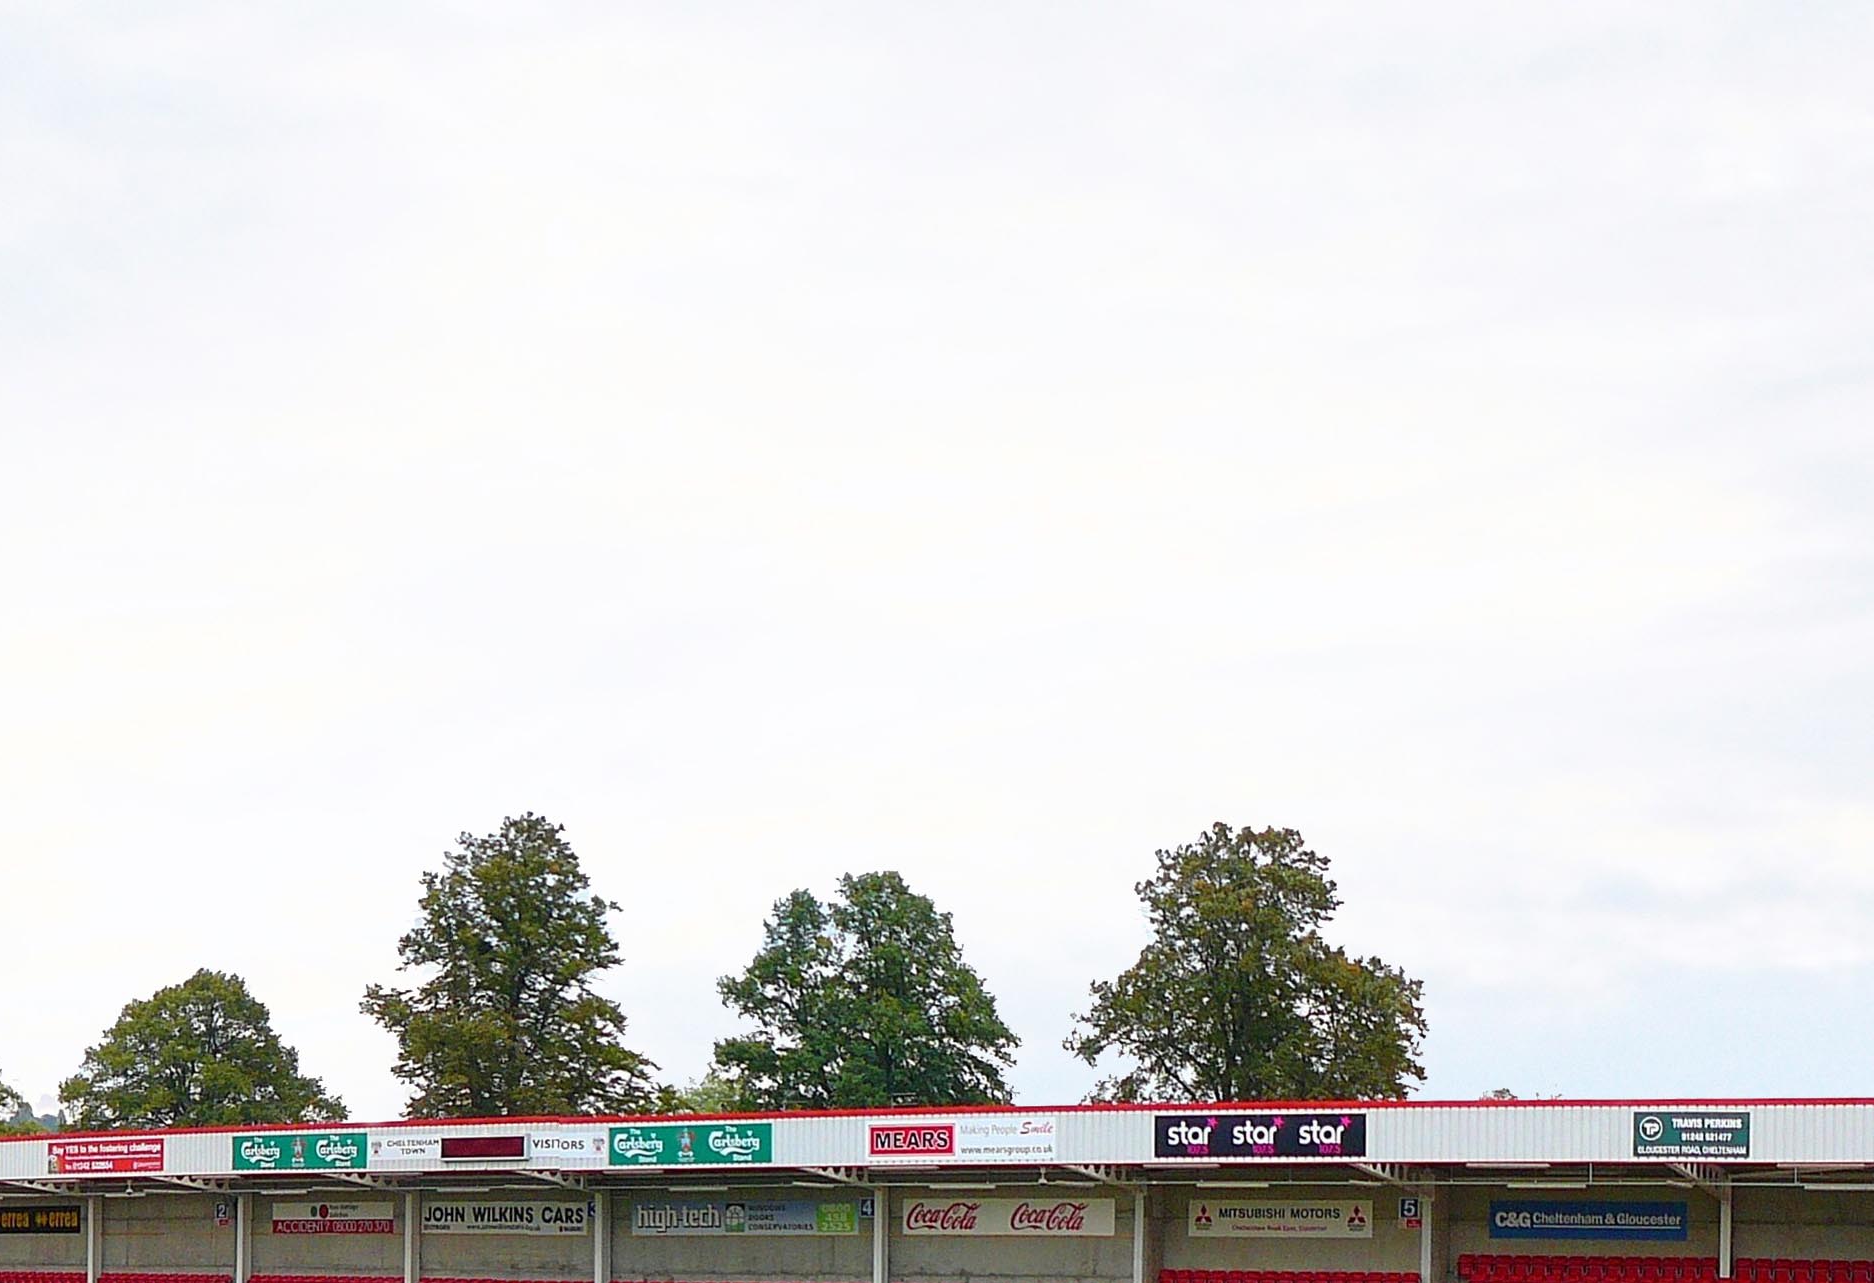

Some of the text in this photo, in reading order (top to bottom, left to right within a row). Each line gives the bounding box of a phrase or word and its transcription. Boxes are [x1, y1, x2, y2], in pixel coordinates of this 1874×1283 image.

[960, 1121, 1053, 1137] Making People Smile
[1672, 1118, 1742, 1129] TRAVIS PERKINS
[1167, 1121, 1211, 1145] star
[1233, 1120, 1277, 1145] star
[1299, 1120, 1344, 1145] star
[386, 1139, 439, 1147] CHELTENHAM
[532, 1139, 585, 1150] VISITORS
[614, 1133, 663, 1153] Carlsberg
[708, 1131, 760, 1152] Carlsberg
[875, 1132, 948, 1149] MEARS
[241, 1141, 280, 1160] Carlsberg
[316, 1139, 357, 1159] Carlsberg
[401, 1147, 425, 1155] TOWN
[1187, 1145, 1209, 1154] 107.5
[1252, 1145, 1274, 1154] 107.5
[1319, 1145, 1341, 1154] 107.5
[1637, 1146, 1746, 1154] GLOUCESTER CHELTENHAM
[217, 1204, 226, 1217] 2
[424, 1206, 584, 1223] JOHN WILKINS CARS
[862, 1200, 872, 1215] 4
[1219, 1208, 1340, 1219] MITSUBISHI MOTORS
[1404, 1201, 1415, 1215] 5
[637, 1204, 721, 1233] high-tech
[906, 1202, 981, 1230] Coca-Cola
[1010, 1202, 1090, 1230] Coca-Cola
[1495, 1212, 1681, 1227] C&G Cheltenham & Gloucester
[277, 1221, 389, 1233] ACCIDENT? 08000 270 370
